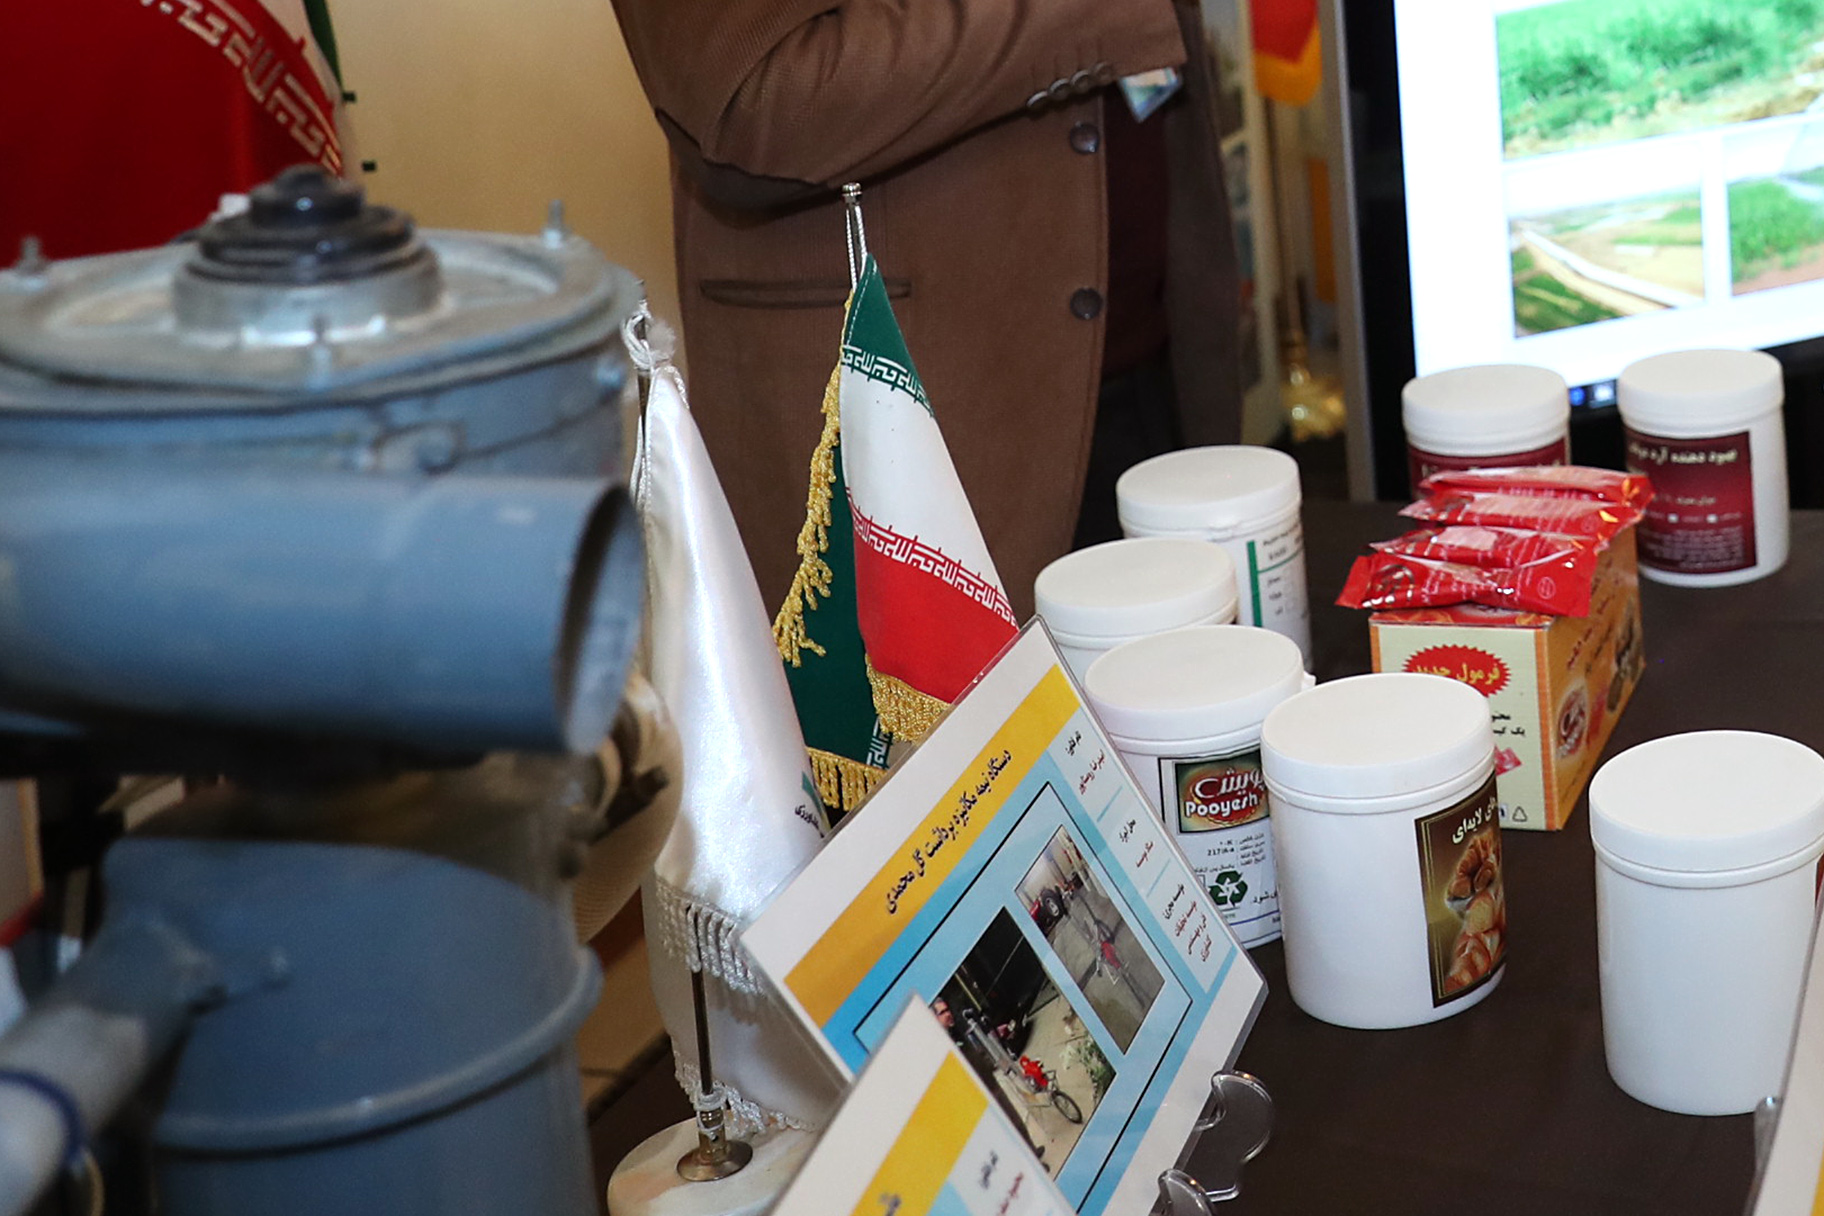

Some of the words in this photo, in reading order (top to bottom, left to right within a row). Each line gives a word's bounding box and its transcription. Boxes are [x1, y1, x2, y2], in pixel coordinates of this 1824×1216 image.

[1456, 662, 1500, 685] فرمول
[987, 749, 1012, 782] دستگاه
[1185, 793, 1259, 818] Pooyesh
[925, 820, 960, 858] برداشت
[912, 848, 925, 877] گل
[886, 870, 915, 915] محمدی
